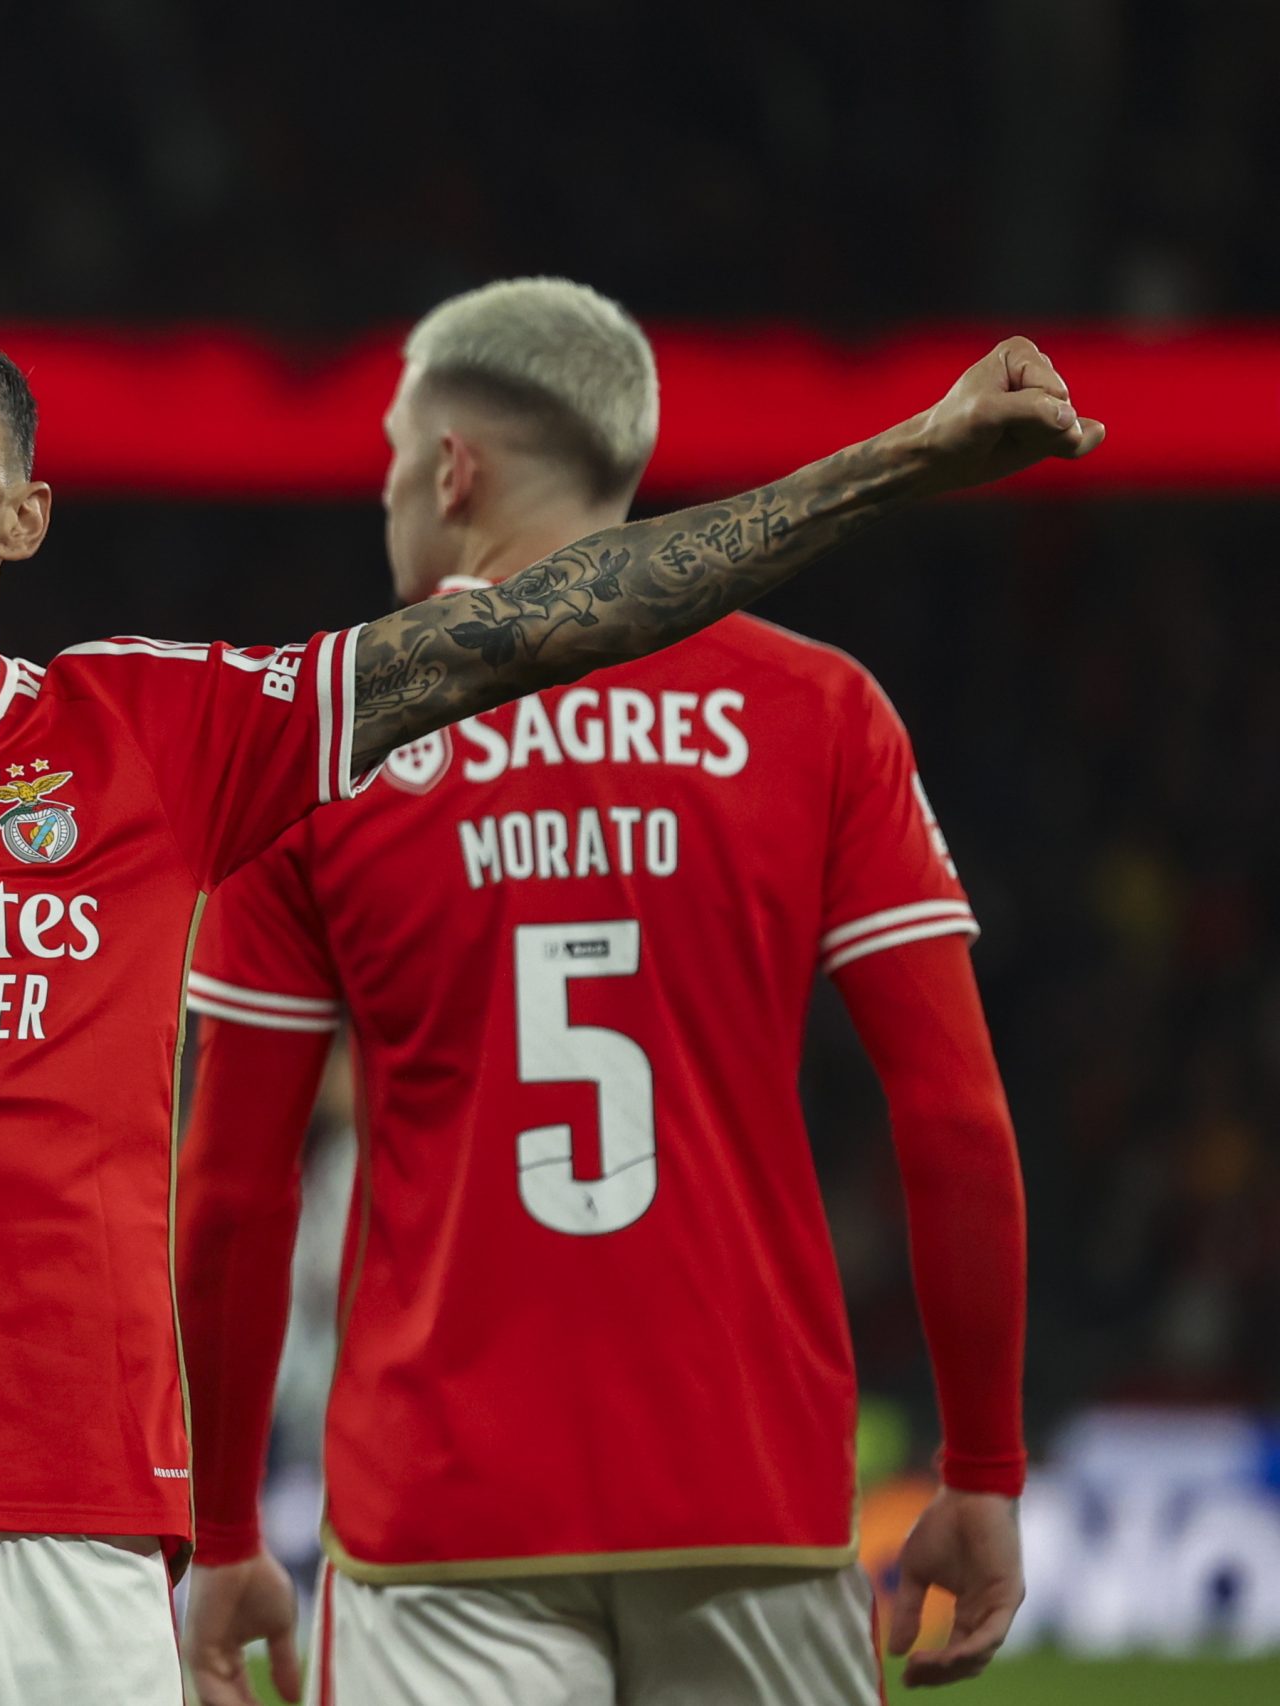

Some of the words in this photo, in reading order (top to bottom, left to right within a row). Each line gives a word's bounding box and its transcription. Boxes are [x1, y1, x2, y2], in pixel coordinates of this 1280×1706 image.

[456, 687, 749, 782] SAGRES
[458, 807, 678, 889] MORATO
[514, 919, 658, 1236] 5
